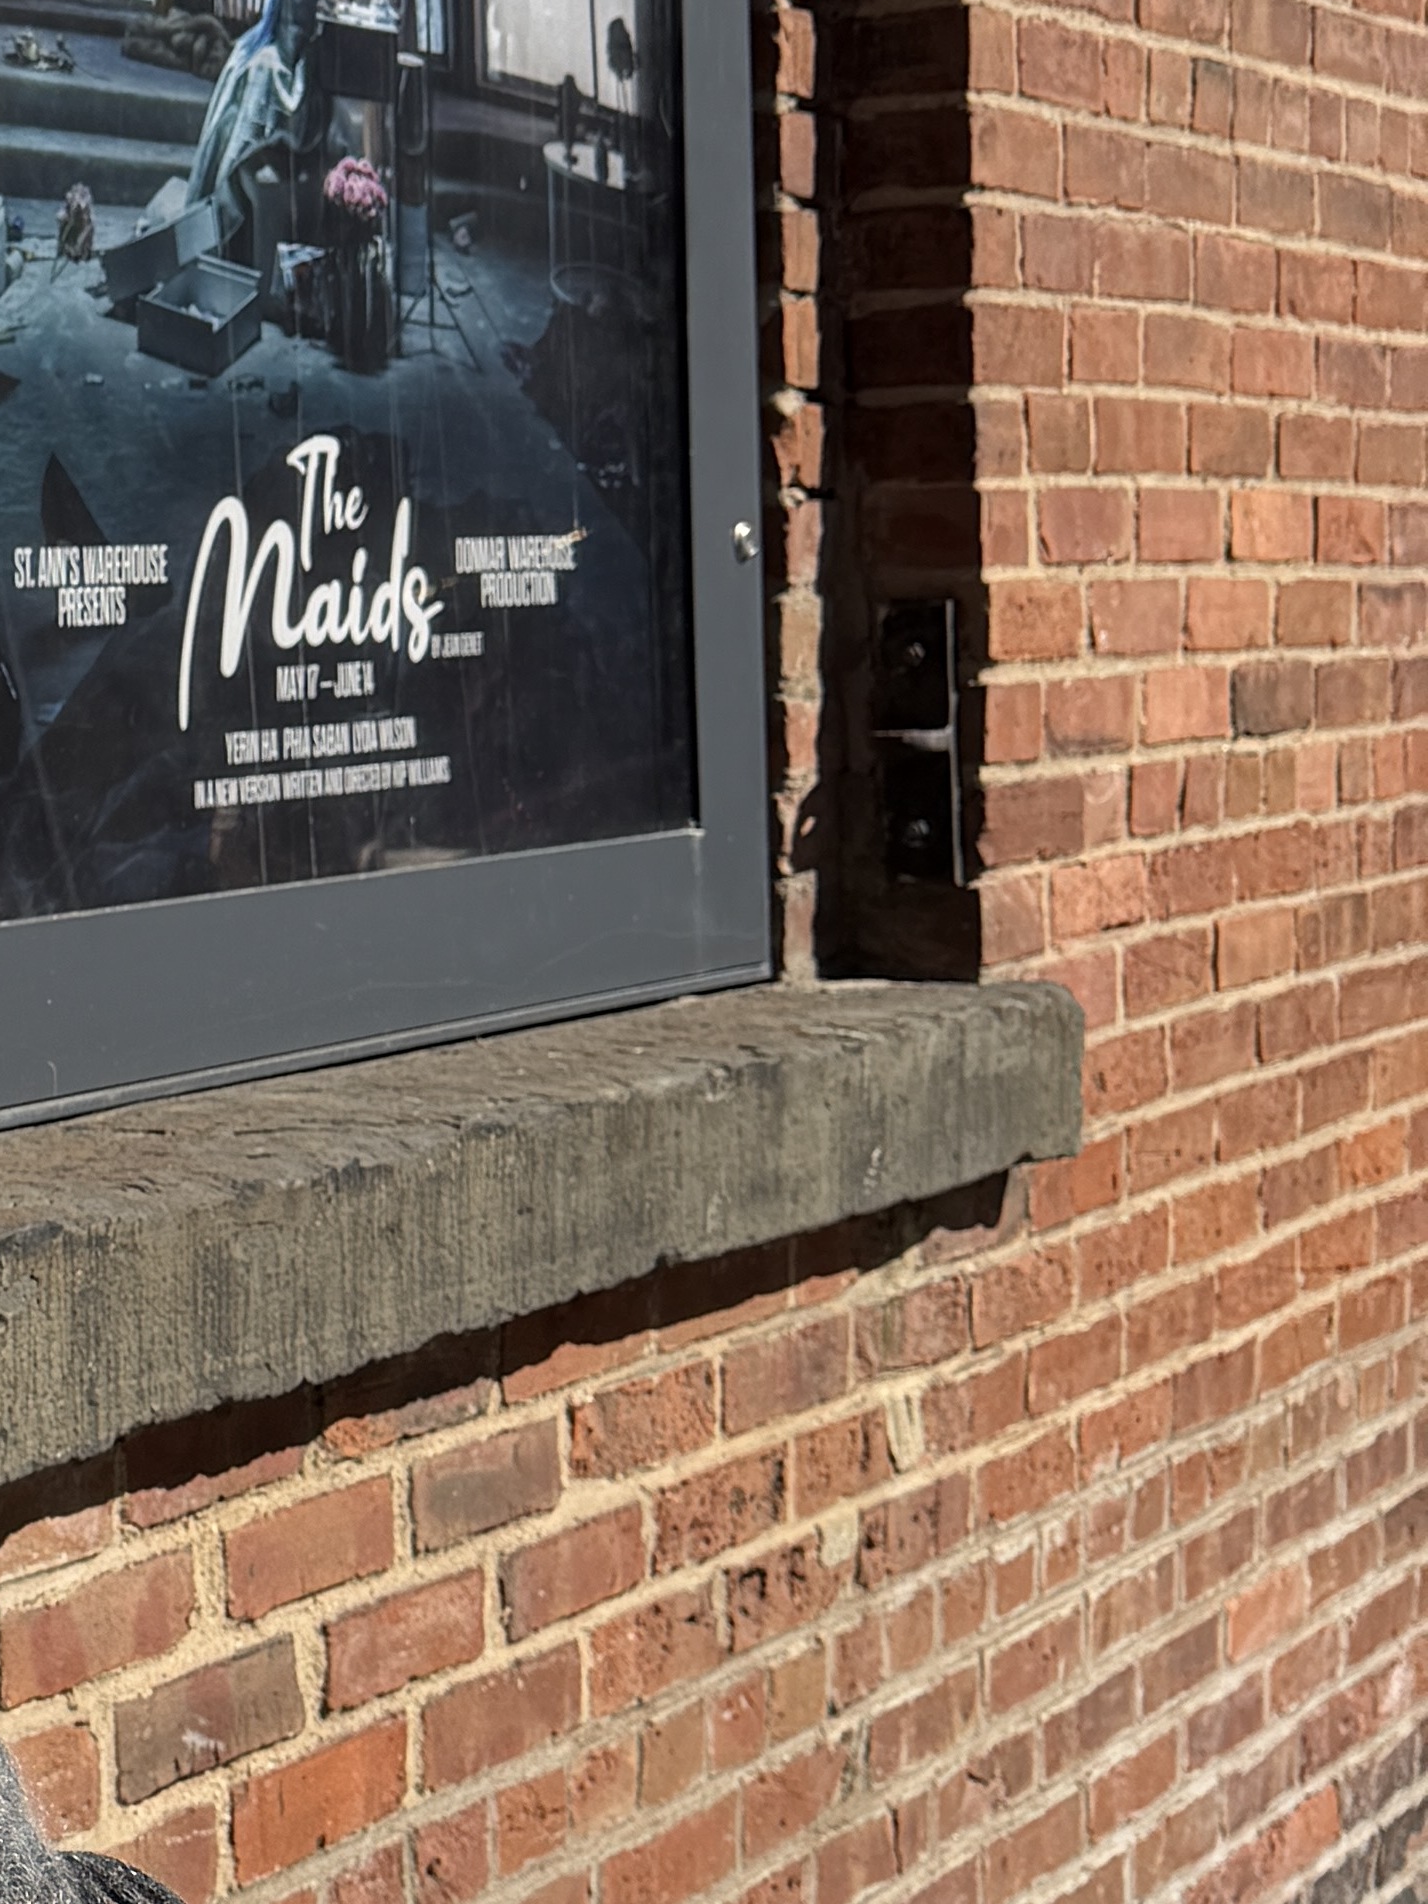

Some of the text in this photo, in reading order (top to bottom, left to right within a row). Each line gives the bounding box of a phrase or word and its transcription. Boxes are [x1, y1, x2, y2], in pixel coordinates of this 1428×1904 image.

[286, 435, 367, 571] The
[14, 544, 168, 588] ST. ANN'S WAREHOUSE
[455, 536, 506, 574] DONMAR
[58, 586, 126, 628] PRESENTS
[480, 570, 558, 608] PRODUCTION
[178, 496, 444, 732] Maids
[276, 664, 306, 702] MAY
[333, 660, 362, 699] JUNE
[215, 777, 239, 807] NEW
[239, 773, 281, 805] VERSION
[281, 769, 323, 801] WRITTEN
[324, 767, 343, 797] AND
